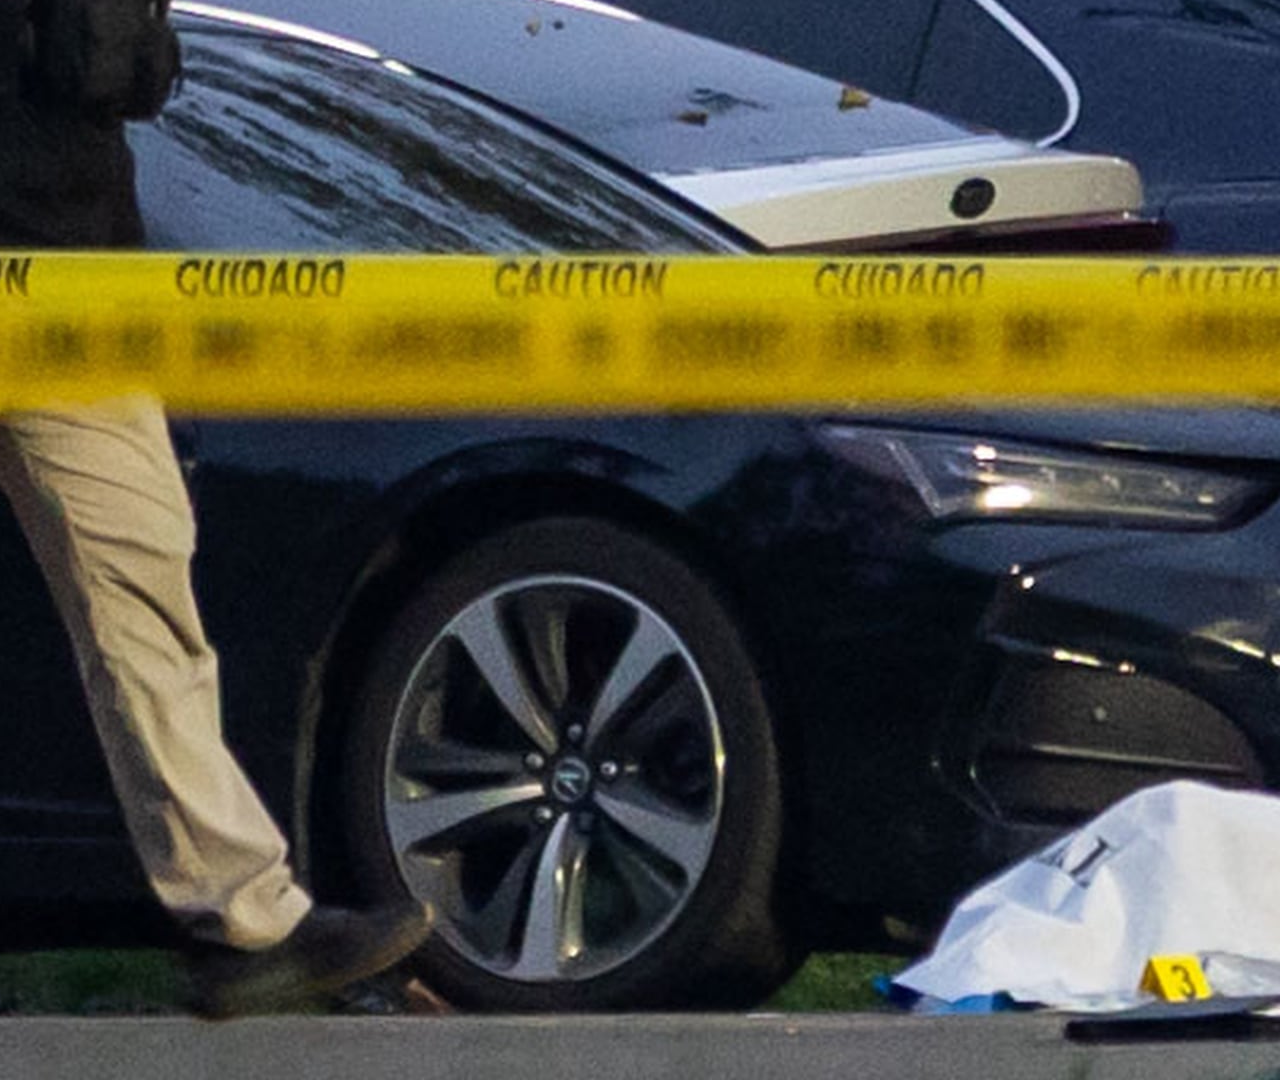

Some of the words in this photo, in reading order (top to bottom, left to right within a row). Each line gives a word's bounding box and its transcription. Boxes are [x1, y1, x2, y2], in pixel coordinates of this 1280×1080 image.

[175, 258, 346, 297] CUIDADO
[494, 260, 668, 298] CAUTION
[1170, 964, 1197, 1002] 3
